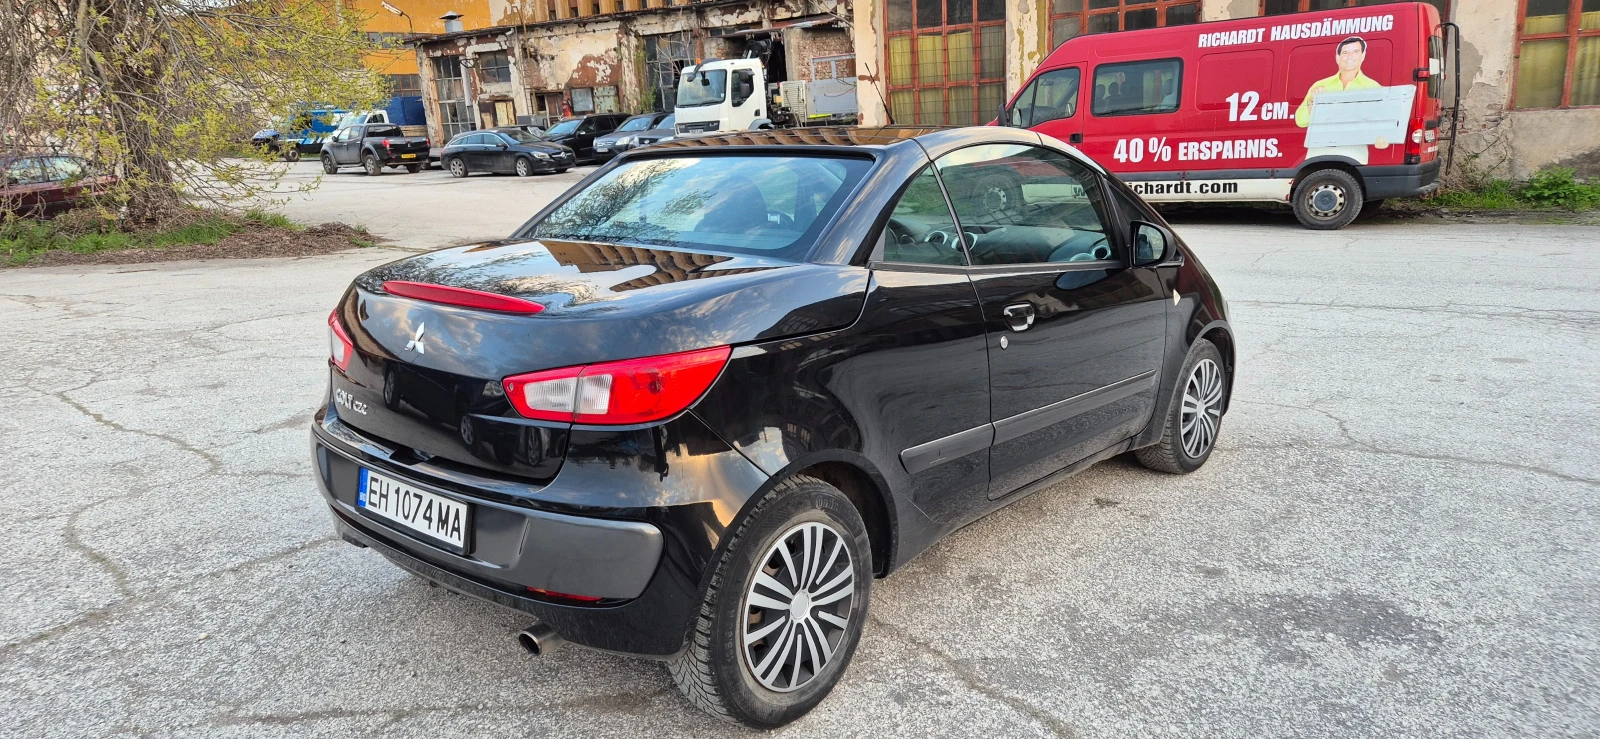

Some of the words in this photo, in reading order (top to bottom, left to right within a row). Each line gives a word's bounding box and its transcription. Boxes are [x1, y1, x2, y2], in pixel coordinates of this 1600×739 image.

[1198, 28, 1265, 48] RICHARDT
[1270, 14, 1394, 41] HAUSDÄMMUNG
[1225, 90, 1260, 122] 12
[1261, 102, 1295, 121] CM.
[1113, 138, 1144, 163] 40
[1148, 136, 1171, 162] %
[1178, 138, 1283, 161] ERSPARNIS.
[336, 388, 353, 409] COLT
[368, 476, 389, 512] EH
[394, 486, 433, 530] 1074
[436, 501, 461, 541] MA
